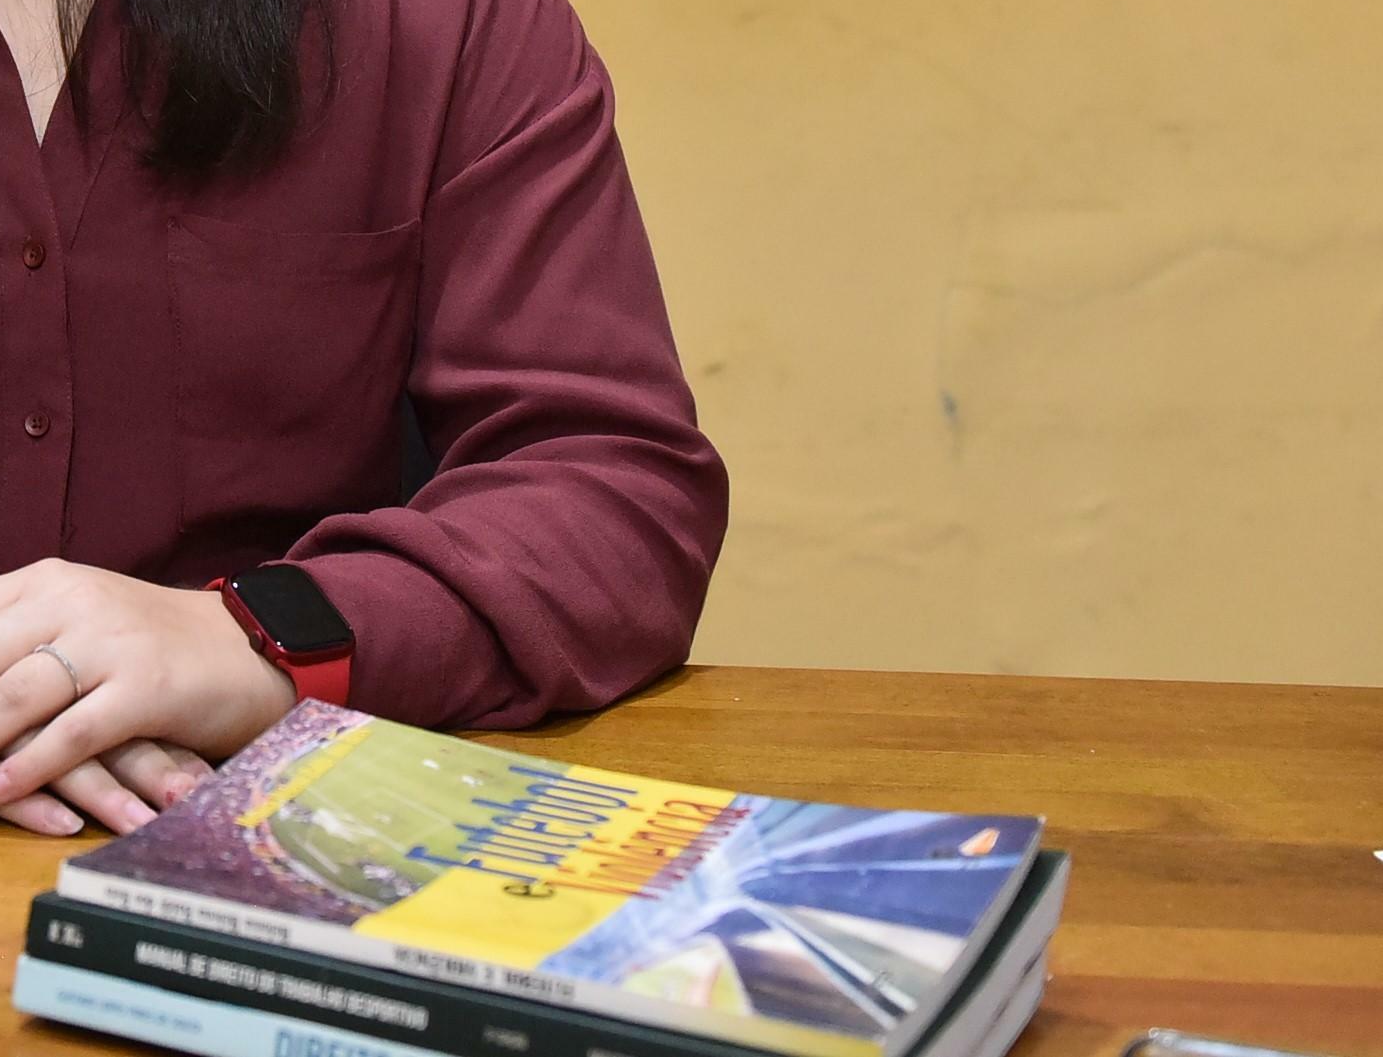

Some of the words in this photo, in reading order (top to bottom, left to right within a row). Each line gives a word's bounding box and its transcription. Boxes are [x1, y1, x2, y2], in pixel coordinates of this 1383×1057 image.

[405, 765, 638, 882] Futebol
[502, 882, 556, 899] e
[544, 800, 751, 900] Violência
